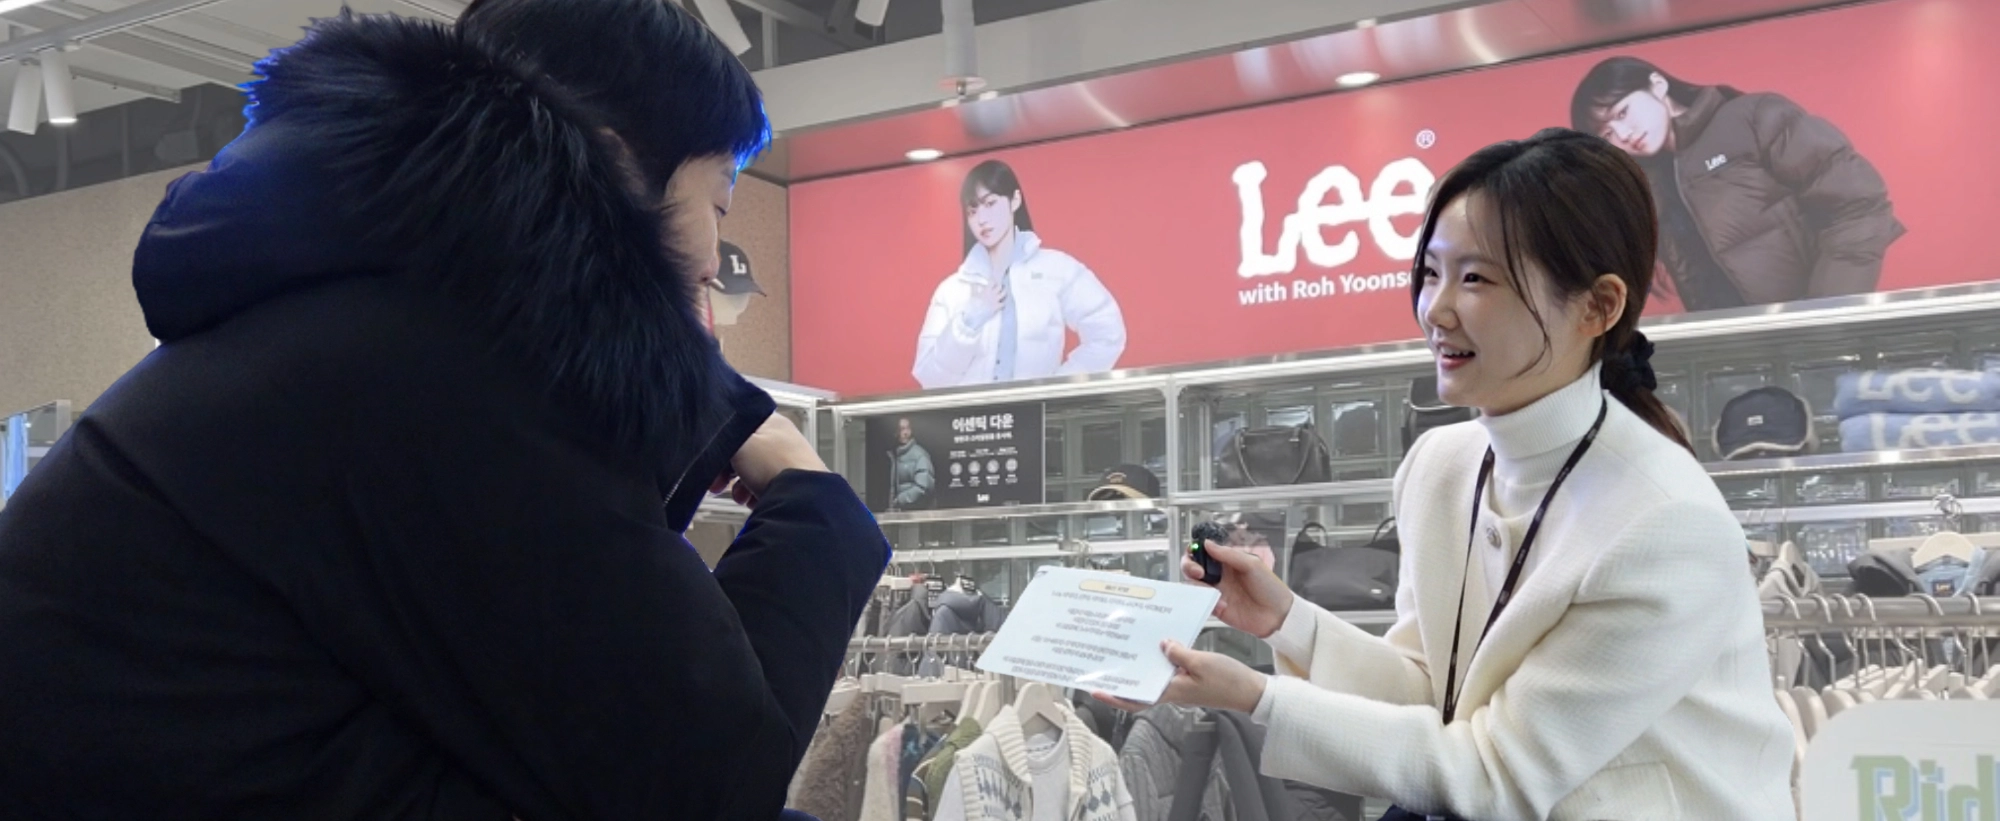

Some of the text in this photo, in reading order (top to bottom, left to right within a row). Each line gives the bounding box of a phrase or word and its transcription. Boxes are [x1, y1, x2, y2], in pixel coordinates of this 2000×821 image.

[1705, 154, 1727, 171] Lee
[1232, 157, 1436, 278] Lee
[728, 254, 748, 275] L
[1239, 282, 1287, 305] with
[1293, 276, 1335, 299] Roh
[989, 412, 1015, 430] 다운
